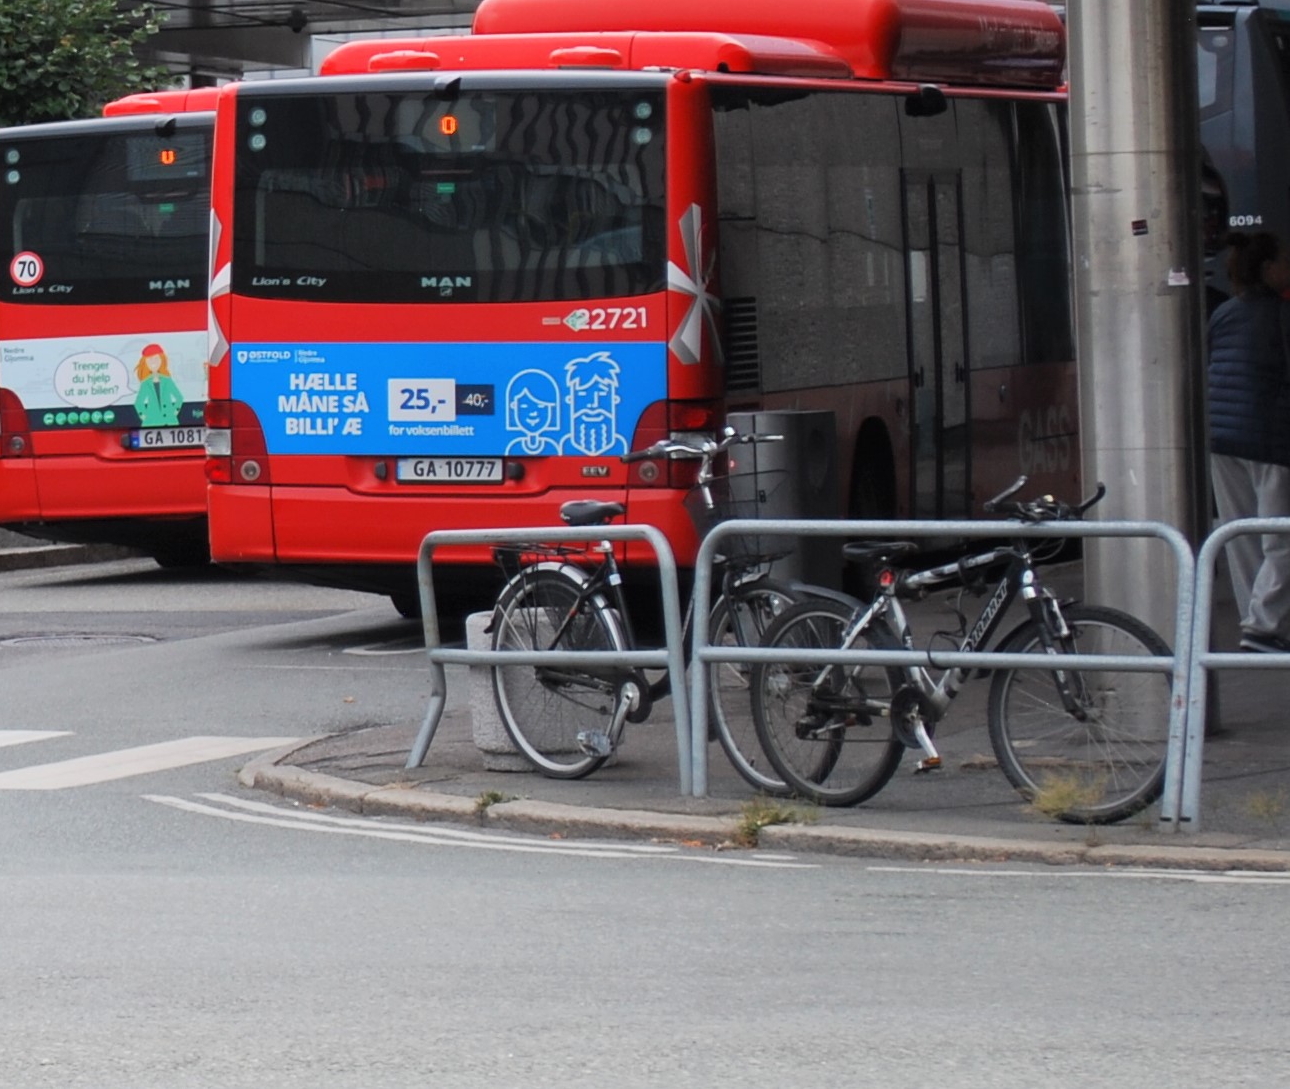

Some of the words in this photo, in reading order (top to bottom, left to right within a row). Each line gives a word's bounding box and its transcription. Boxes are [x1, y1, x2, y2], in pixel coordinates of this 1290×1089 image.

[1229, 214, 1263, 227] 6094
[18, 261, 36, 277] 70
[149, 279, 191, 290] MAN
[252, 276, 290, 286] Lion's
[297, 276, 327, 287] City
[421, 276, 472, 287] MAN
[12, 285, 44, 295] Lion's
[49, 284, 73, 294] City
[249, 351, 291, 360] ØSTFOLD
[73, 361, 109, 373] Trenger
[72, 374, 86, 384] du
[87, 373, 111, 385] hjelp
[289, 373, 357, 391] HÆLLE
[65, 388, 75, 397] ut
[77, 388, 88, 396] av
[91, 385, 120, 396] bilen?
[278, 391, 338, 413] MÅNE
[342, 391, 369, 413] SÅ
[400, 388, 446, 414] 25,-
[342, 418, 362, 435] Æ
[388, 425, 404, 436] for
[406, 424, 474, 436] voksenbillett
[144, 431, 163, 445] GA
[169, 429, 206, 443] 1081
[413, 461, 437, 477] GA
[445, 460, 497, 477] 10777
